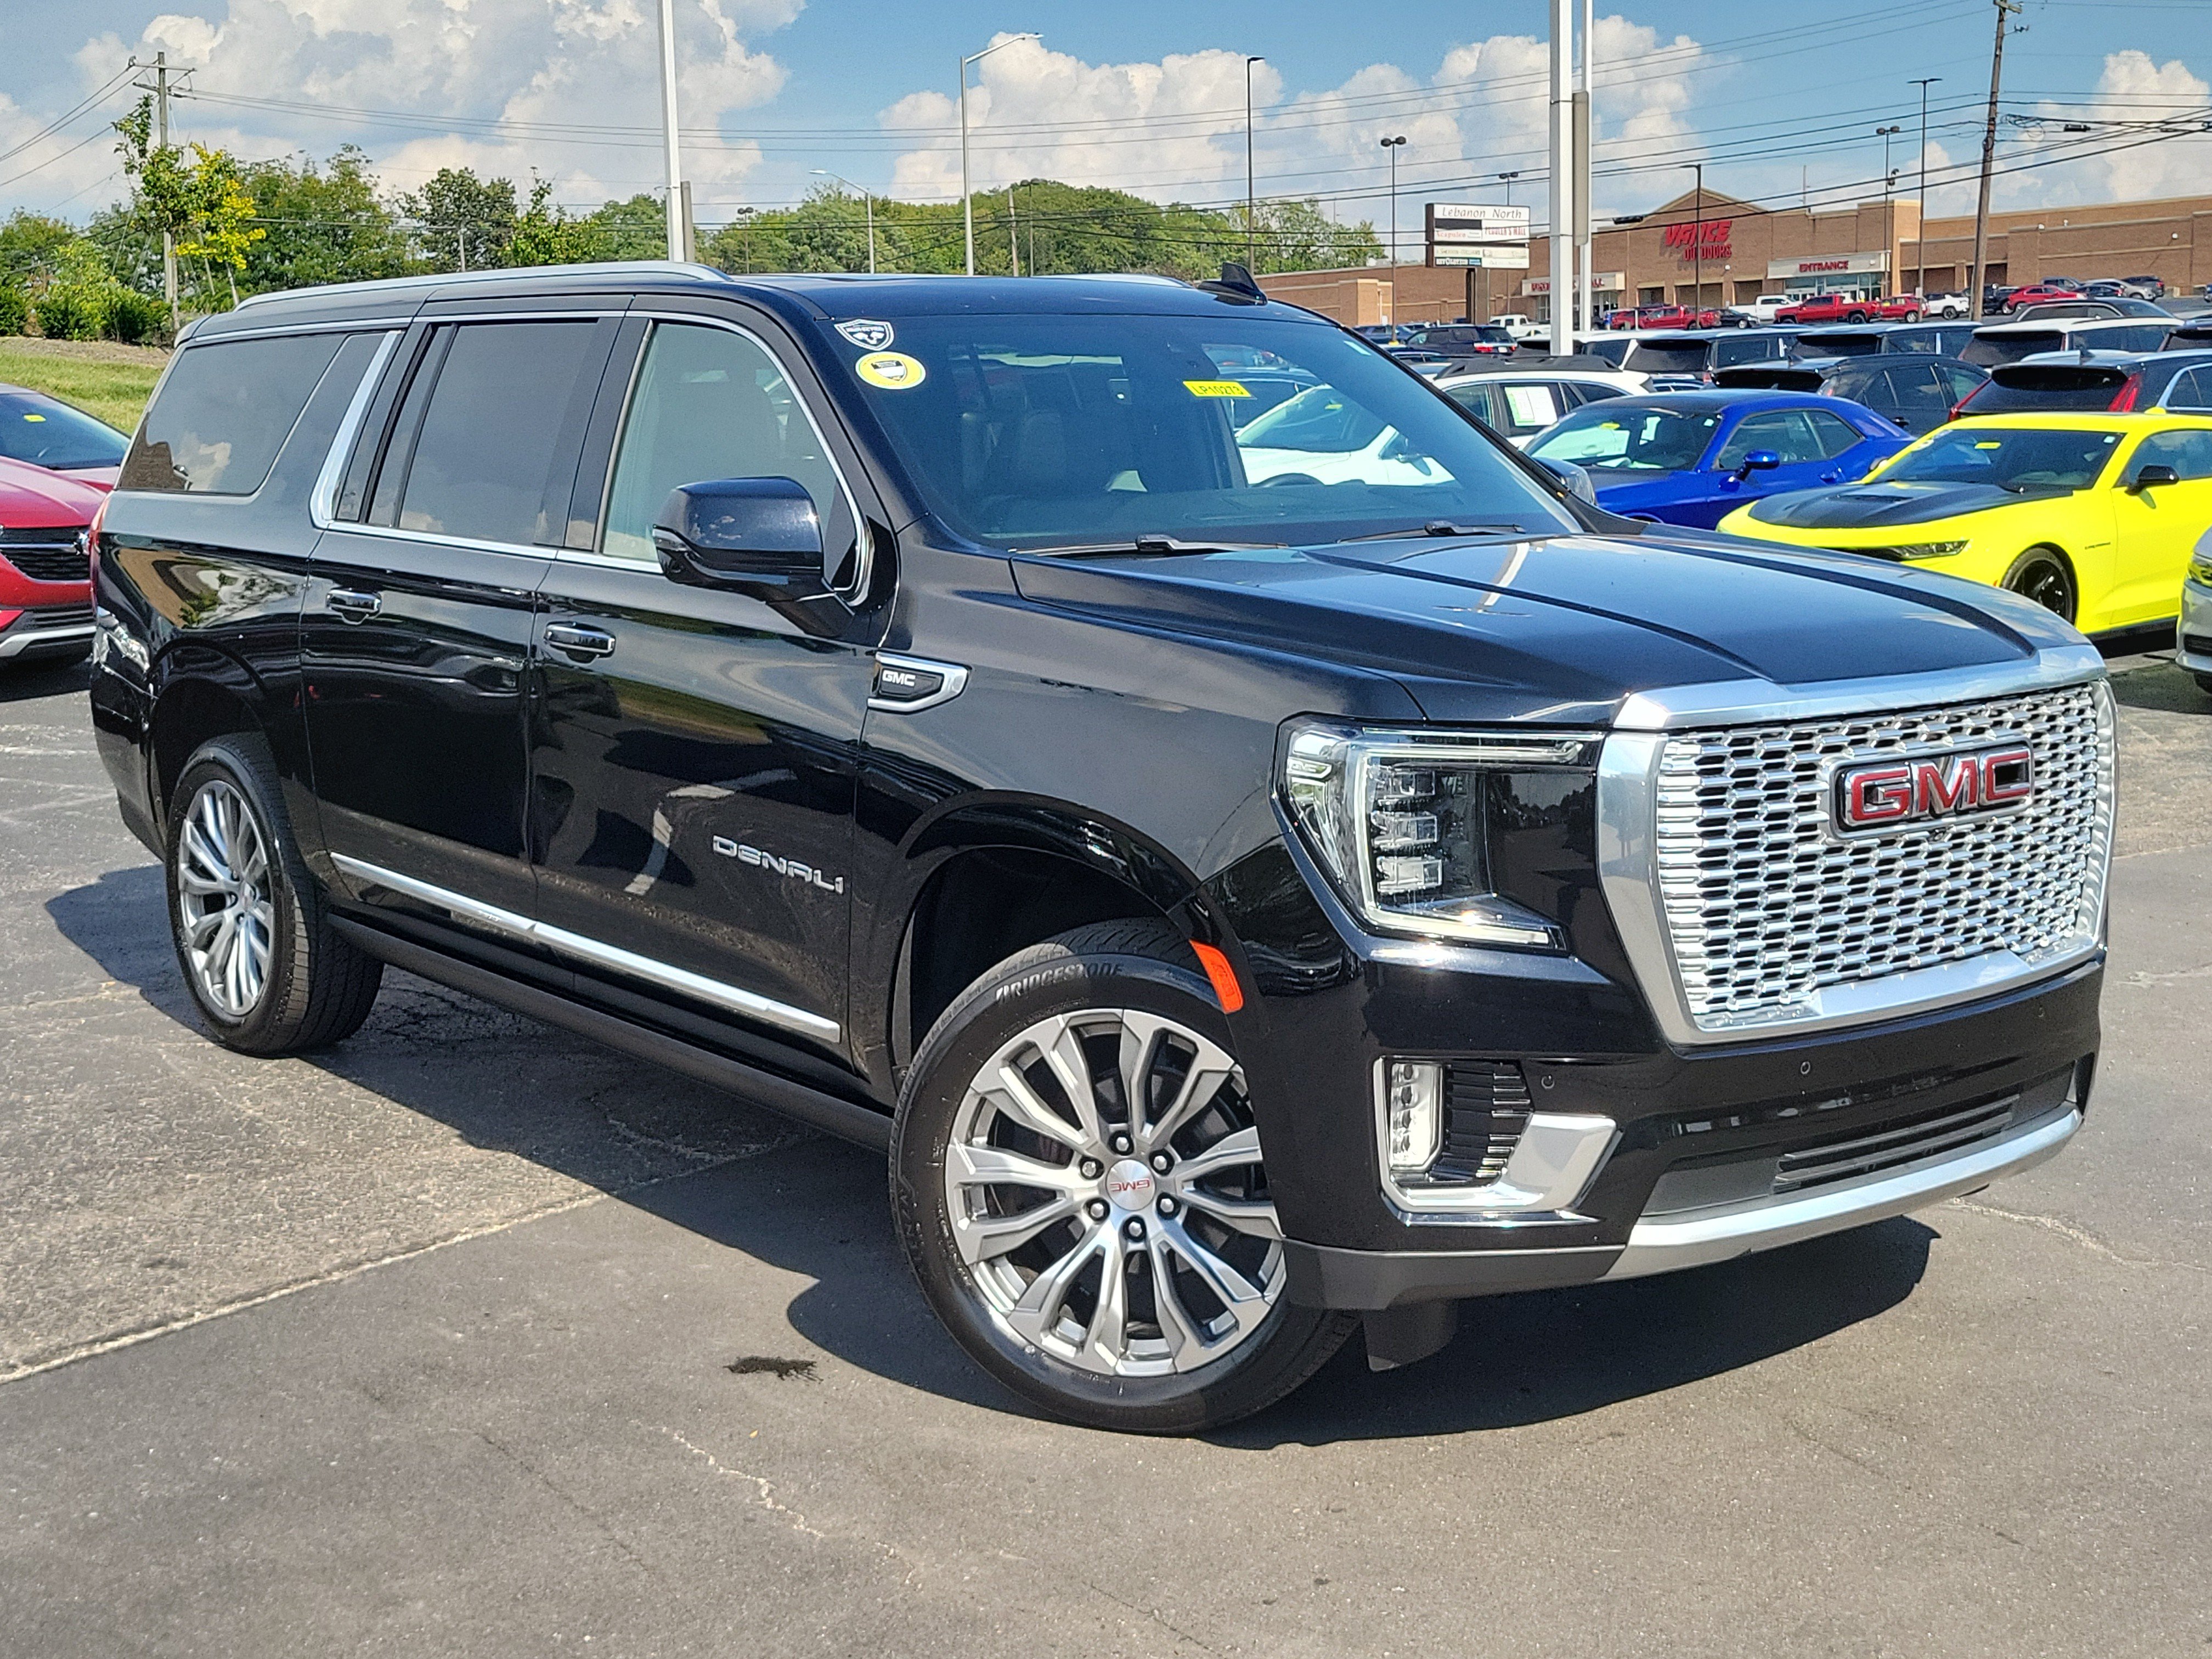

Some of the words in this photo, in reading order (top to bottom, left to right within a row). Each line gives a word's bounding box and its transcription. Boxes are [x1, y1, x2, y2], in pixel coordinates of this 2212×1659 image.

[1442, 207, 1486, 218] Lebanon
[1492, 208, 1521, 218] North
[1799, 261, 1849, 272] ENTRANCE
[882, 670, 916, 687] GMC
[1845, 749, 2031, 825] GMC
[713, 834, 844, 895] DENALI
[1109, 1178, 1150, 1192] GMC
